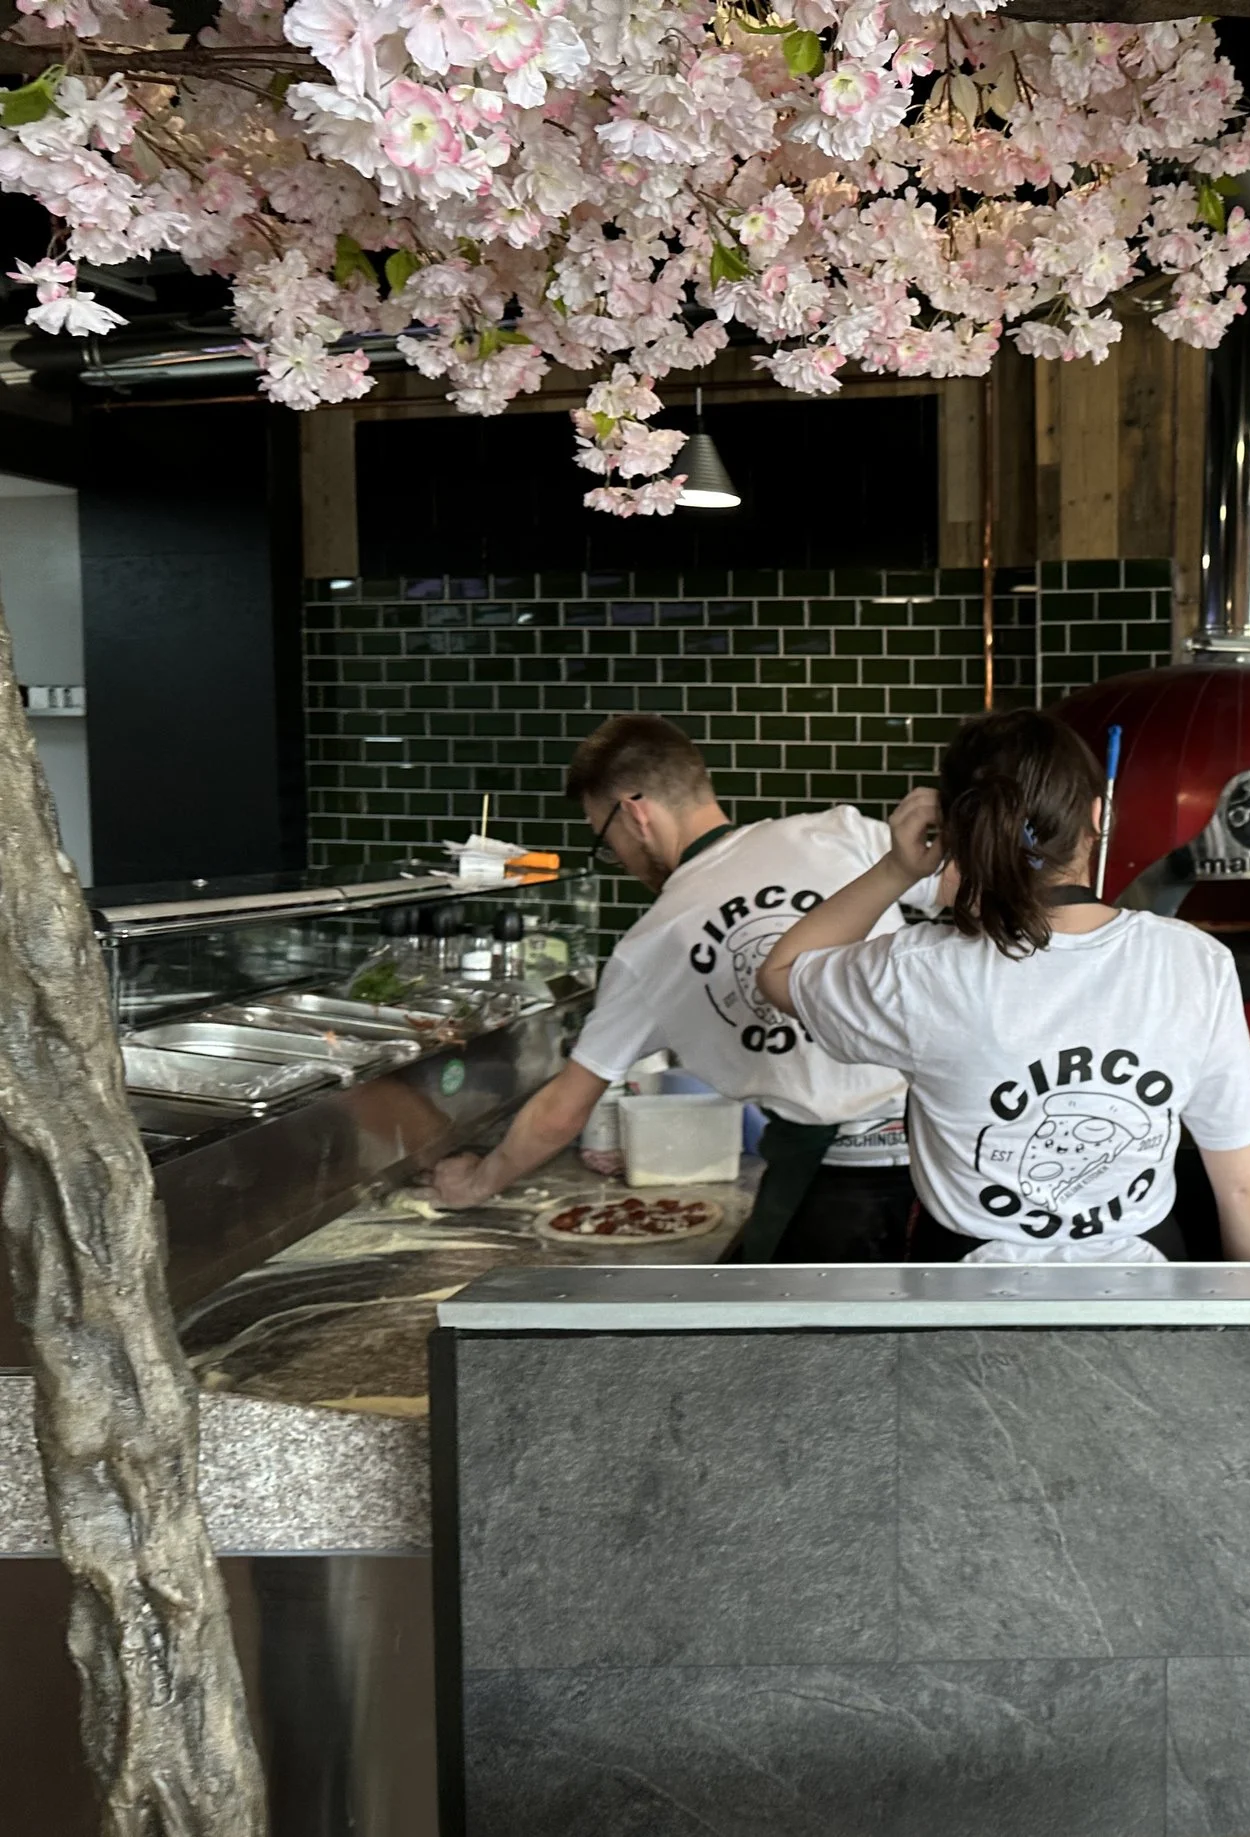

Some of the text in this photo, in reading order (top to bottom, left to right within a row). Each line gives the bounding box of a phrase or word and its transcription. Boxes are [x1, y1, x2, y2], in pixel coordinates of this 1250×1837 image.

[690, 885, 824, 974] CIRCO
[990, 1046, 1173, 1121] CIRCO
[990, 1149, 1013, 1162] EST
[979, 1168, 1155, 1240] CIRCO
